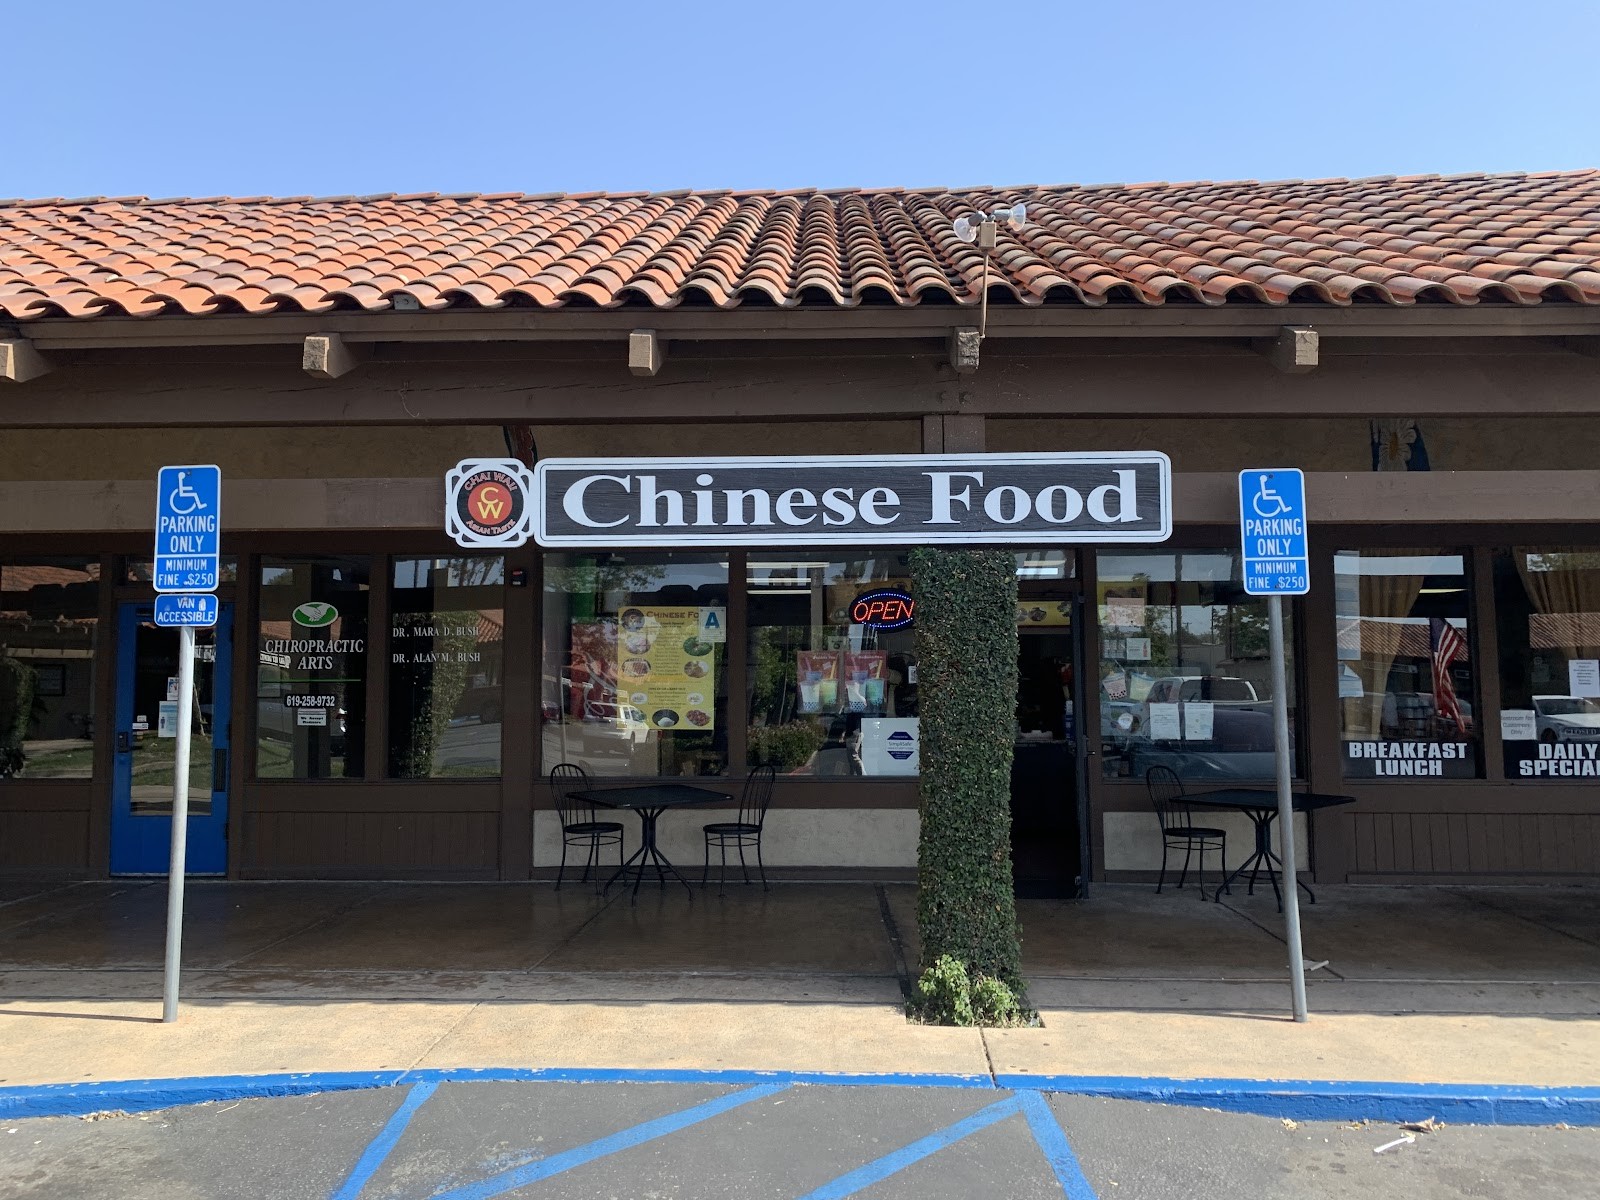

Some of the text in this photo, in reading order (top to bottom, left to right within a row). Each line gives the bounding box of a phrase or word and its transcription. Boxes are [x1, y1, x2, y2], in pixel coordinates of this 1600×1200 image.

[464, 471, 491, 491] CHAI
[562, 469, 1144, 529] Chinese Food
[160, 515, 215, 533] PARKING
[1246, 518, 1302, 536] PARKING
[170, 535, 204, 553] ONLY
[1257, 538, 1292, 556] ONLY
[165, 559, 207, 571] MINIMUM
[1255, 562, 1297, 574] MINIMUM
[158, 573, 214, 586] FINE $250
[1248, 576, 1304, 589] FINE $250
[177, 598, 195, 609] VAN
[854, 600, 915, 621] OPEN
[157, 611, 214, 623] ACCESSIBLE
[646, 611, 700, 619] CHINESE FO
[704, 611, 720, 629] A
[392, 627, 410, 637] DR.
[414, 627, 440, 636] MARA
[456, 626, 479, 636] BUSH
[265, 639, 364, 653] CHIROPRACTIC
[297, 656, 333, 670] ARTS
[392, 653, 410, 663] DR.
[413, 652, 437, 662] ALAN
[458, 652, 480, 662] BUSH
[286, 696, 336, 707] 619-258-9732
[1349, 742, 1467, 758] BREAKFAST
[1538, 744, 1598, 759] DAILY
[1375, 760, 1442, 776] LUNCH
